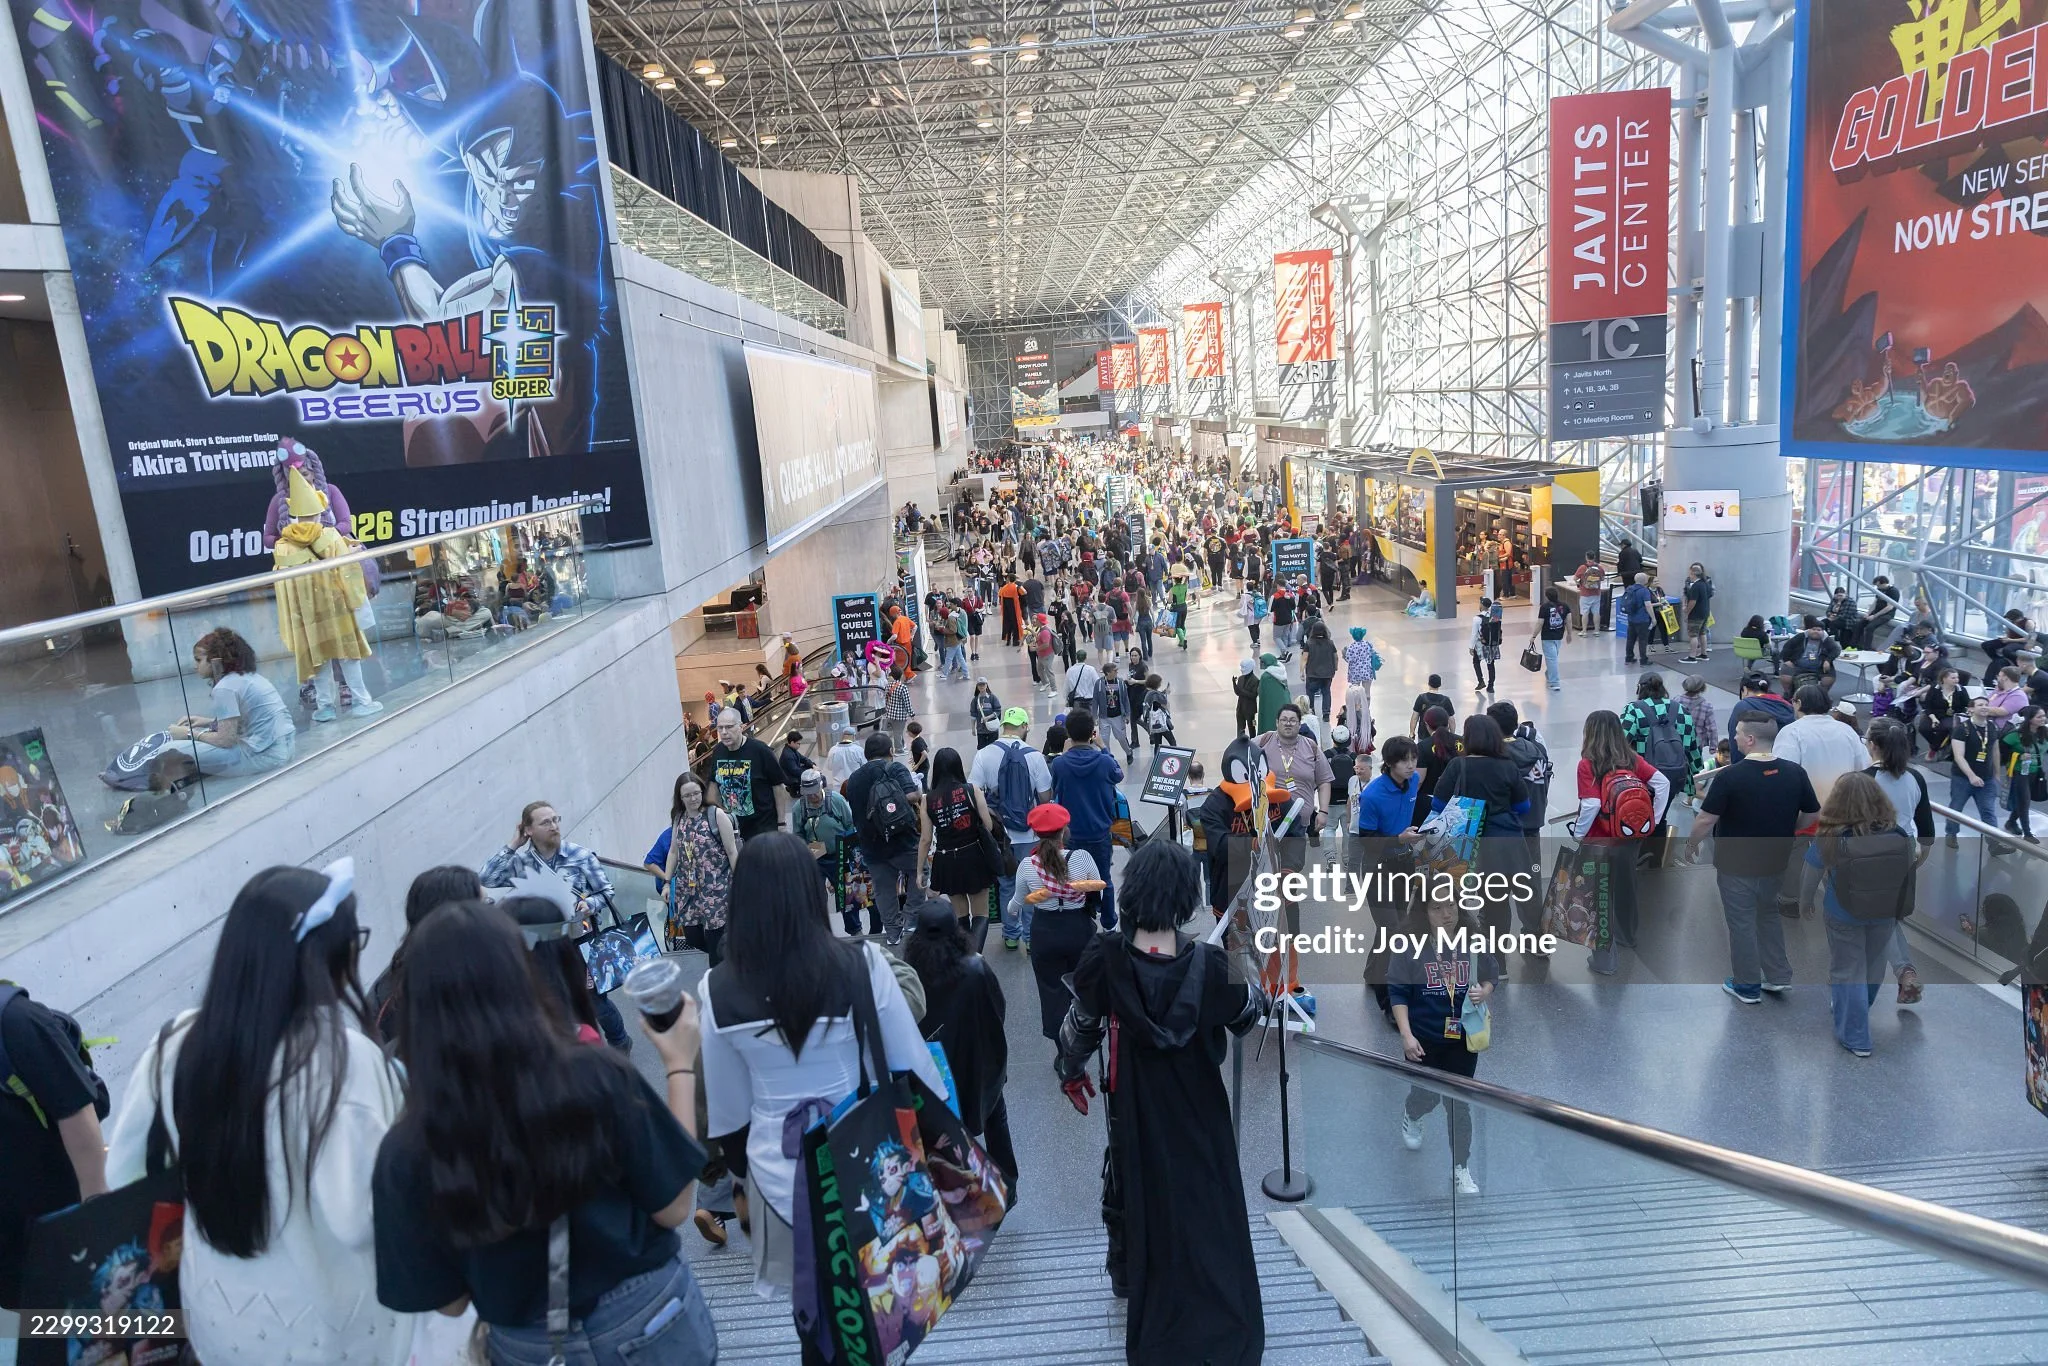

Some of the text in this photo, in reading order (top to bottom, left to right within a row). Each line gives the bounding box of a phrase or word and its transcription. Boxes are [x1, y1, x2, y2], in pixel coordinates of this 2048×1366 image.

[1829, 21, 2048, 172] GOLDE
[1962, 163, 2009, 196] NEW
[1573, 123, 1608, 290] JAVITS
[1622, 119, 1650, 288] CENTER
[1894, 209, 1963, 253] NOW
[169, 297, 494, 397] DRAGON BALL
[1582, 318, 1640, 361] 1C
[1100, 356, 1108, 385] JAVITS
[1573, 369, 1612, 379] Javits North
[1610, 383, 1619, 391] 3B
[493, 379, 553, 398] SUPER
[300, 389, 481, 422] BEERUS
[1583, 415, 1610, 424] Meeting
[1610, 413, 1634, 422] Rooms
[128, 432, 279, 451] Original Work, Story & Character Design
[132, 449, 277, 477] Akira Toriyama
[779, 454, 815, 505] QUEUE
[190, 524, 274, 563] Octo
[350, 510, 393, 542] 26
[400, 500, 525, 537] Streaming
[841, 621, 873, 629] QUEUE
[846, 631, 870, 640] HALL
[988, 884, 998, 919] TOON
[820, 1176, 855, 1278] NYCC
